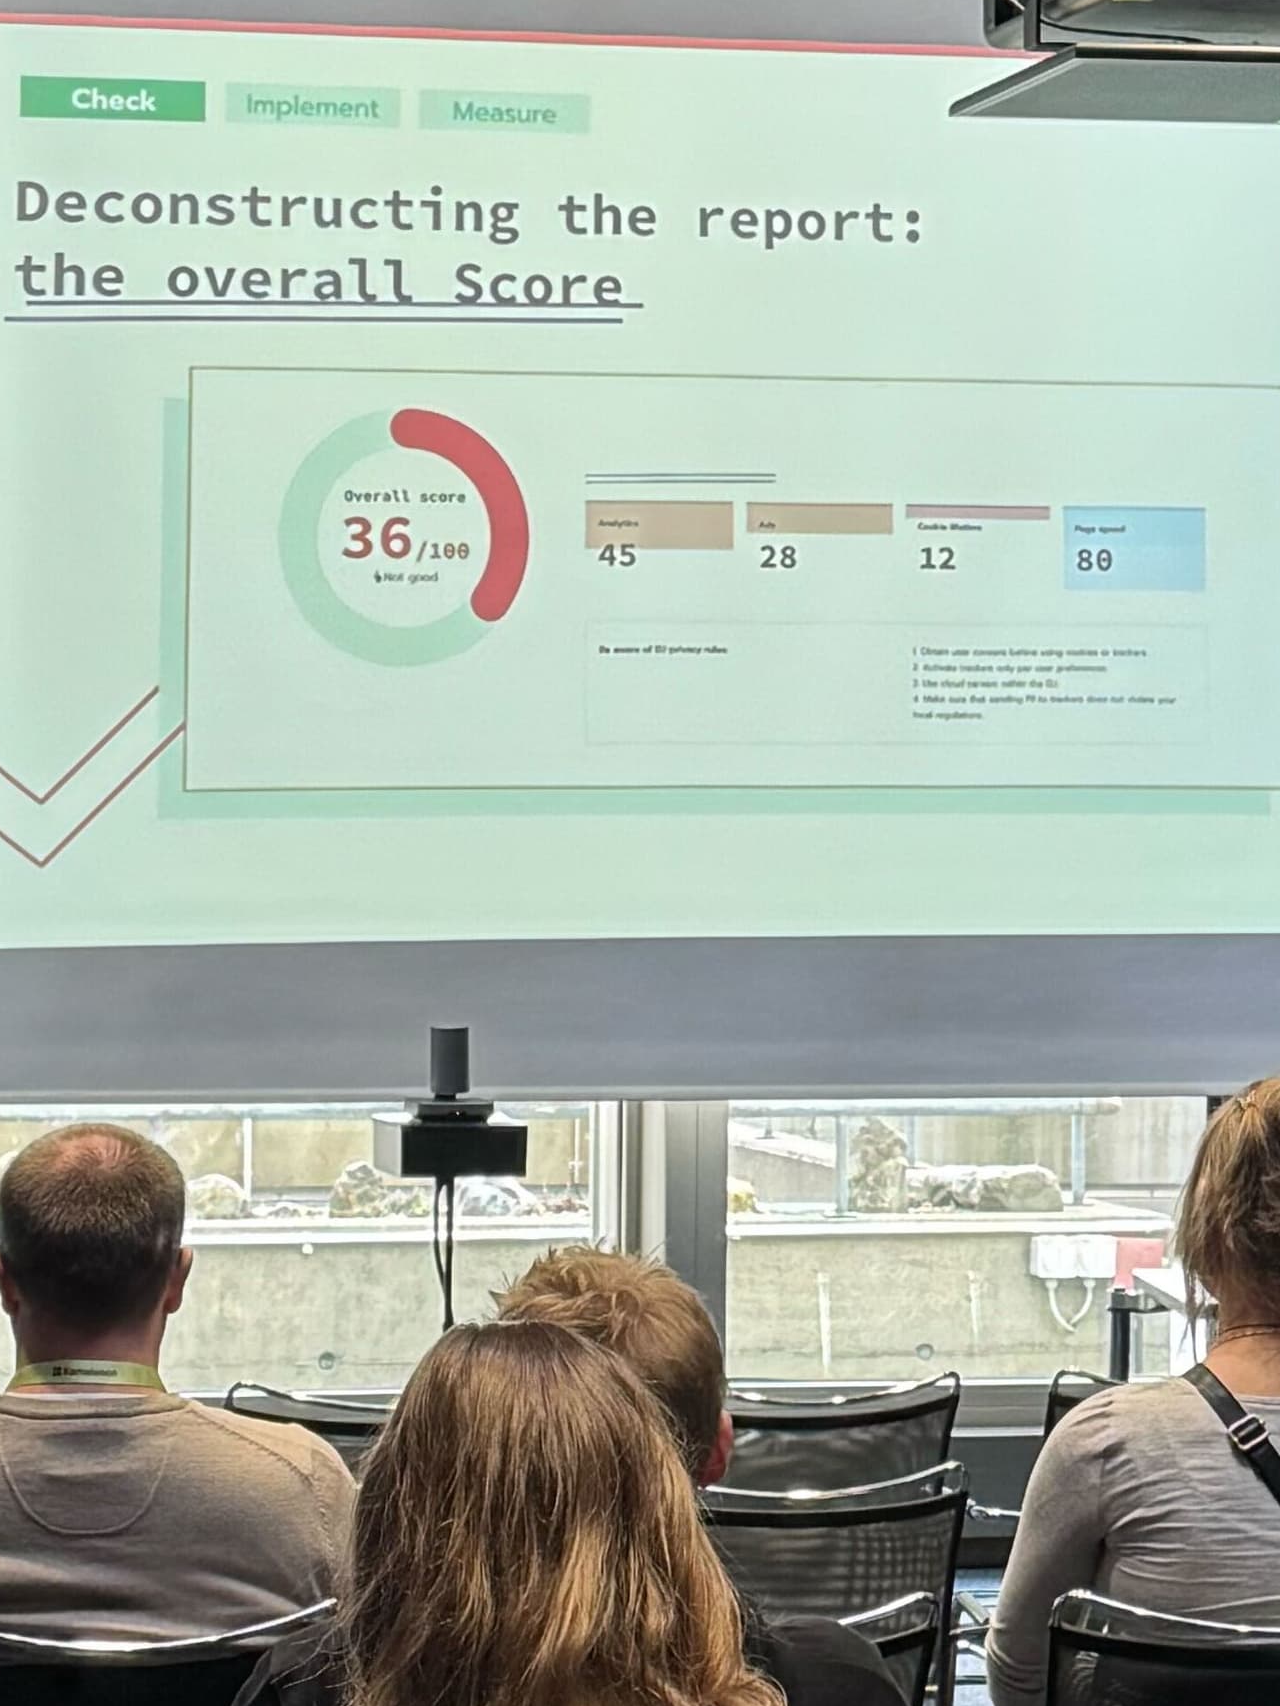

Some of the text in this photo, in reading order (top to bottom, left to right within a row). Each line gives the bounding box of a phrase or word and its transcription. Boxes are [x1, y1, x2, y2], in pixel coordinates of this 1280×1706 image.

[71, 87, 156, 113] Check
[246, 94, 380, 121] Implement
[452, 100, 558, 125] Measure
[16, 180, 920, 251] Deconstructing the report:
[15, 252, 624, 305] the overall Score
[343, 489, 467, 504] Overall score
[598, 544, 637, 568] 45
[759, 544, 798, 570] 28
[919, 546, 957, 571] 12
[1076, 548, 1113, 573] 80
[408, 571, 440, 585] good
